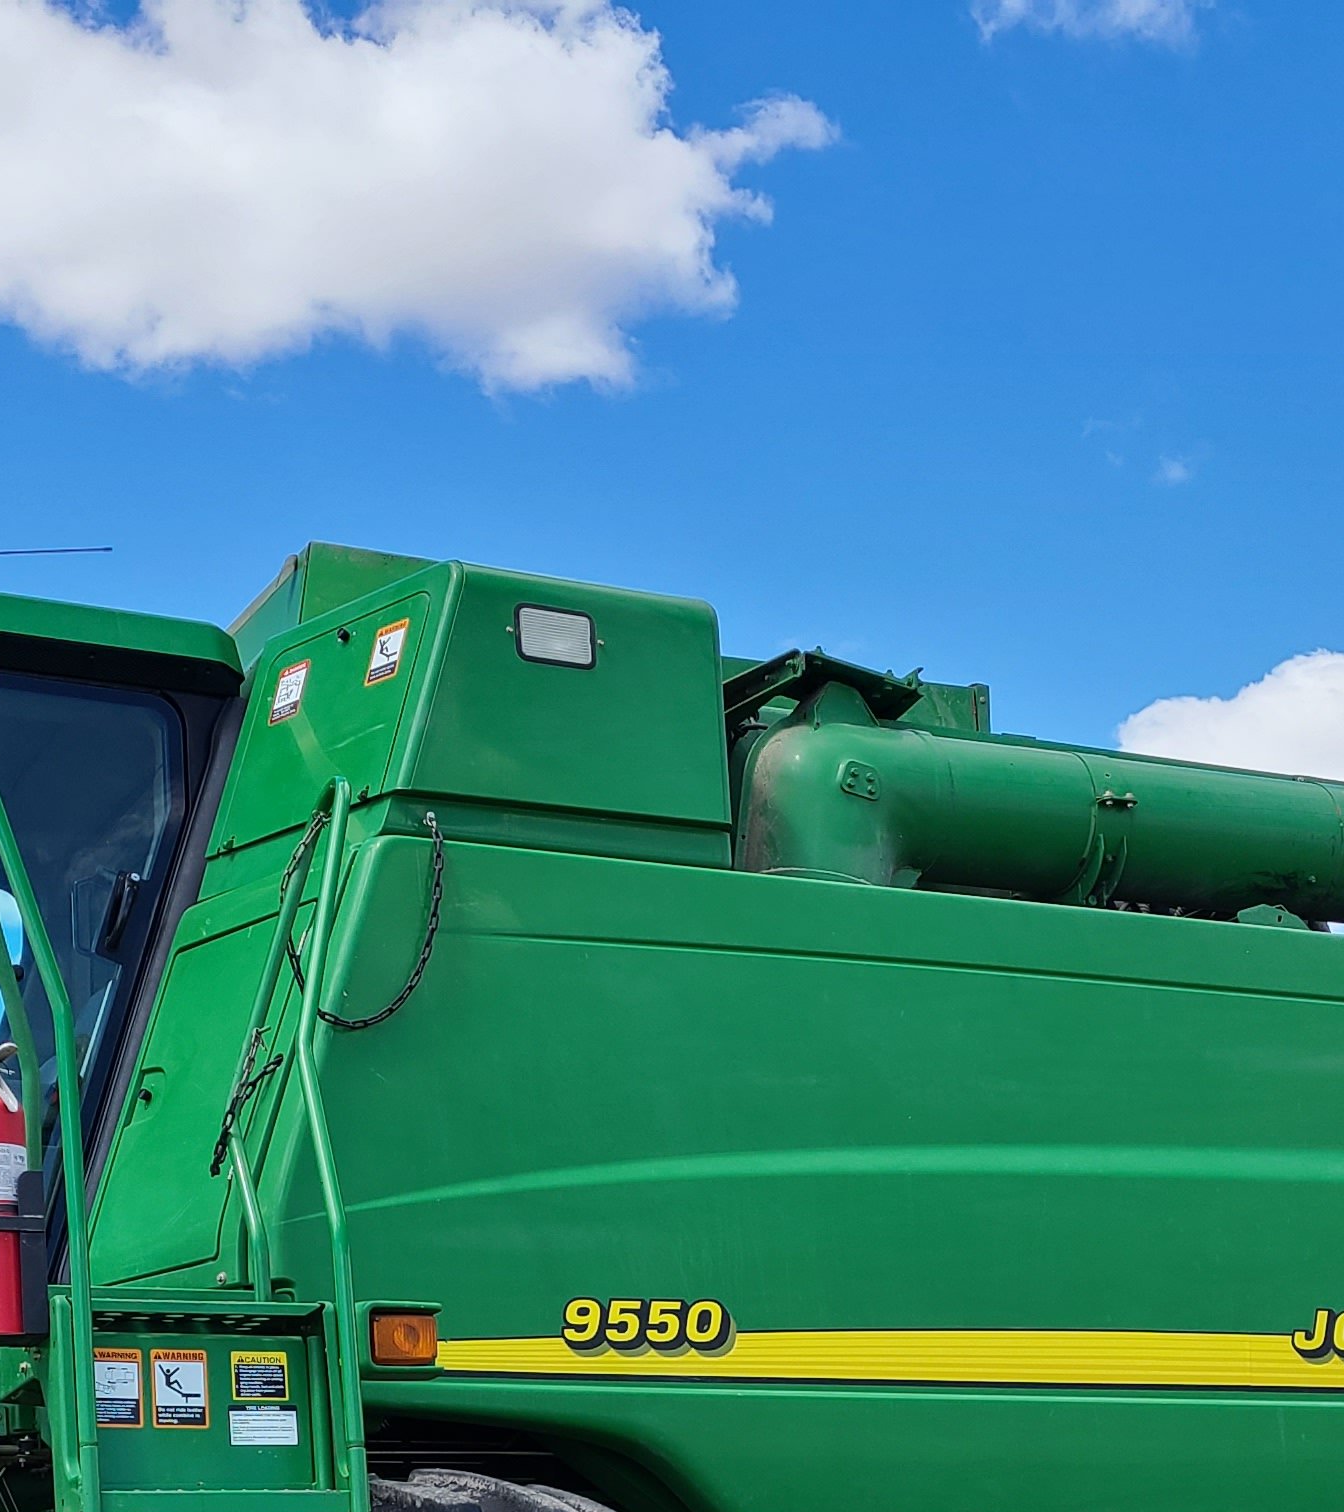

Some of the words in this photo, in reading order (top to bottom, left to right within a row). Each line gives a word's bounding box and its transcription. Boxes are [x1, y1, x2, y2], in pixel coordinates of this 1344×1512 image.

[561, 1296, 732, 1351] 9550
[98, 1351, 138, 1360] WARNING
[161, 1352, 204, 1361] WARNING
[244, 1356, 282, 1364] CAUTION
